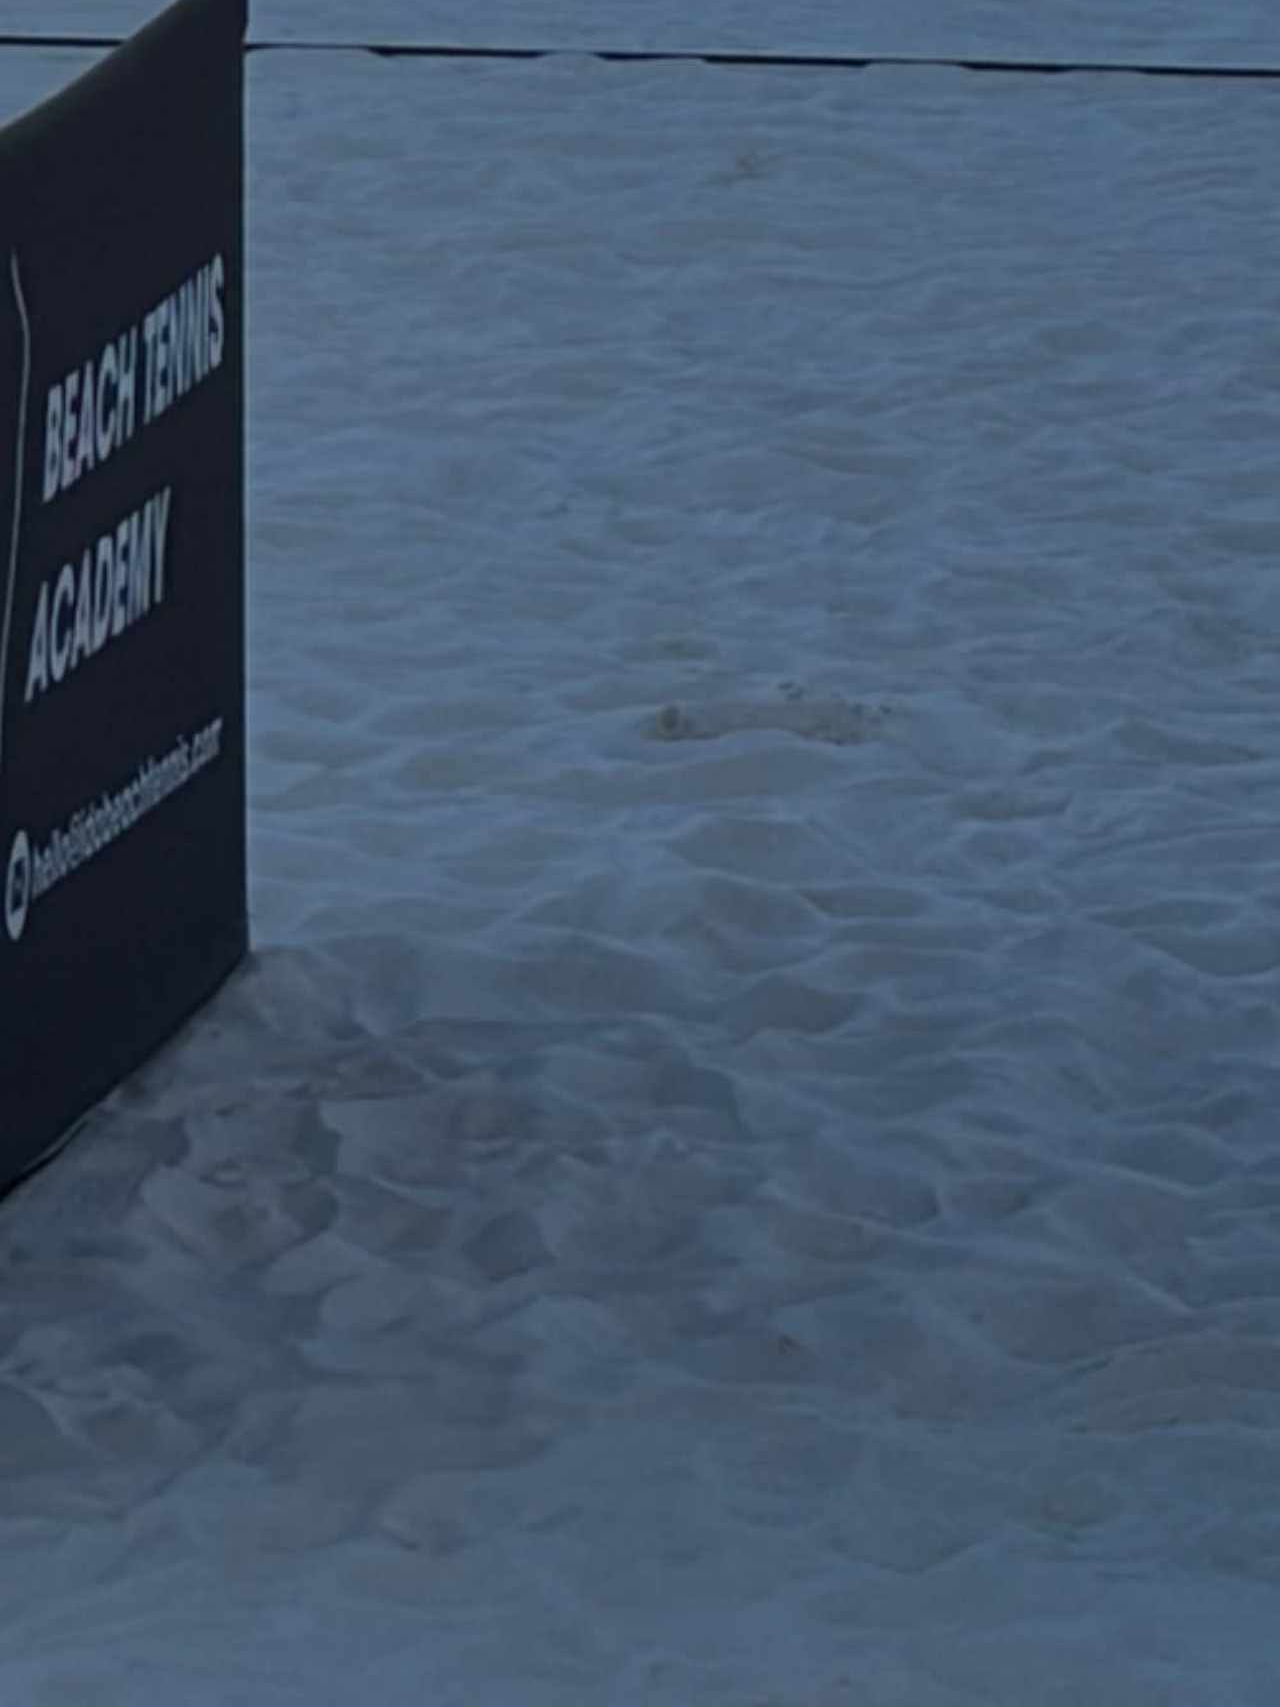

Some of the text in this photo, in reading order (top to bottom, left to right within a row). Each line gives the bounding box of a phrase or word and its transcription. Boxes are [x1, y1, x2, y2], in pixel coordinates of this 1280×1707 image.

[43, 252, 224, 503] BEACH TENNIS
[24, 486, 171, 703] ACADEMY
